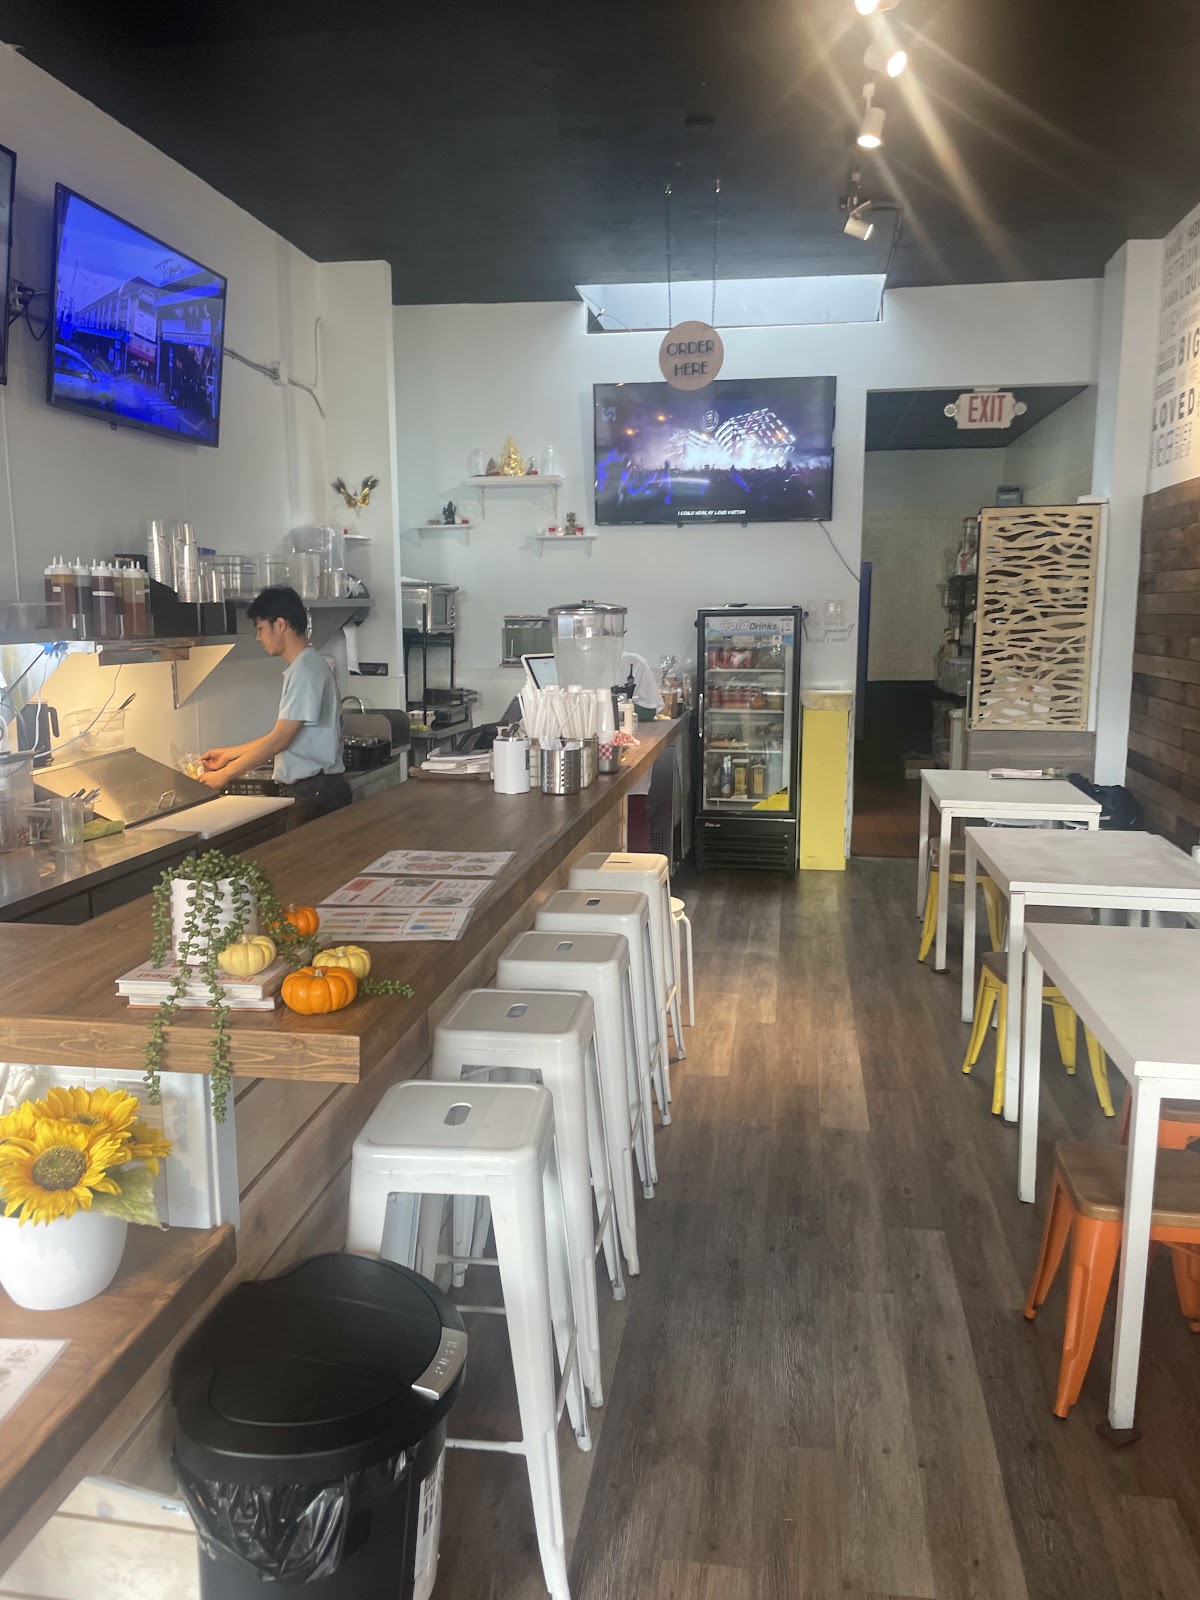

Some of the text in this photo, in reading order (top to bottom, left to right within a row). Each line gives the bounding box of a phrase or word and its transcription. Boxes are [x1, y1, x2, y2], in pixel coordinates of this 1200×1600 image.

[666, 340, 715, 356] ORDER
[1177, 327, 1200, 367] BIG
[674, 361, 709, 376] HERE
[967, 395, 1006, 423] EXIT
[1152, 387, 1195, 432] LOVED
[720, 620, 749, 630] Cold
[749, 622, 777, 630] Drinks
